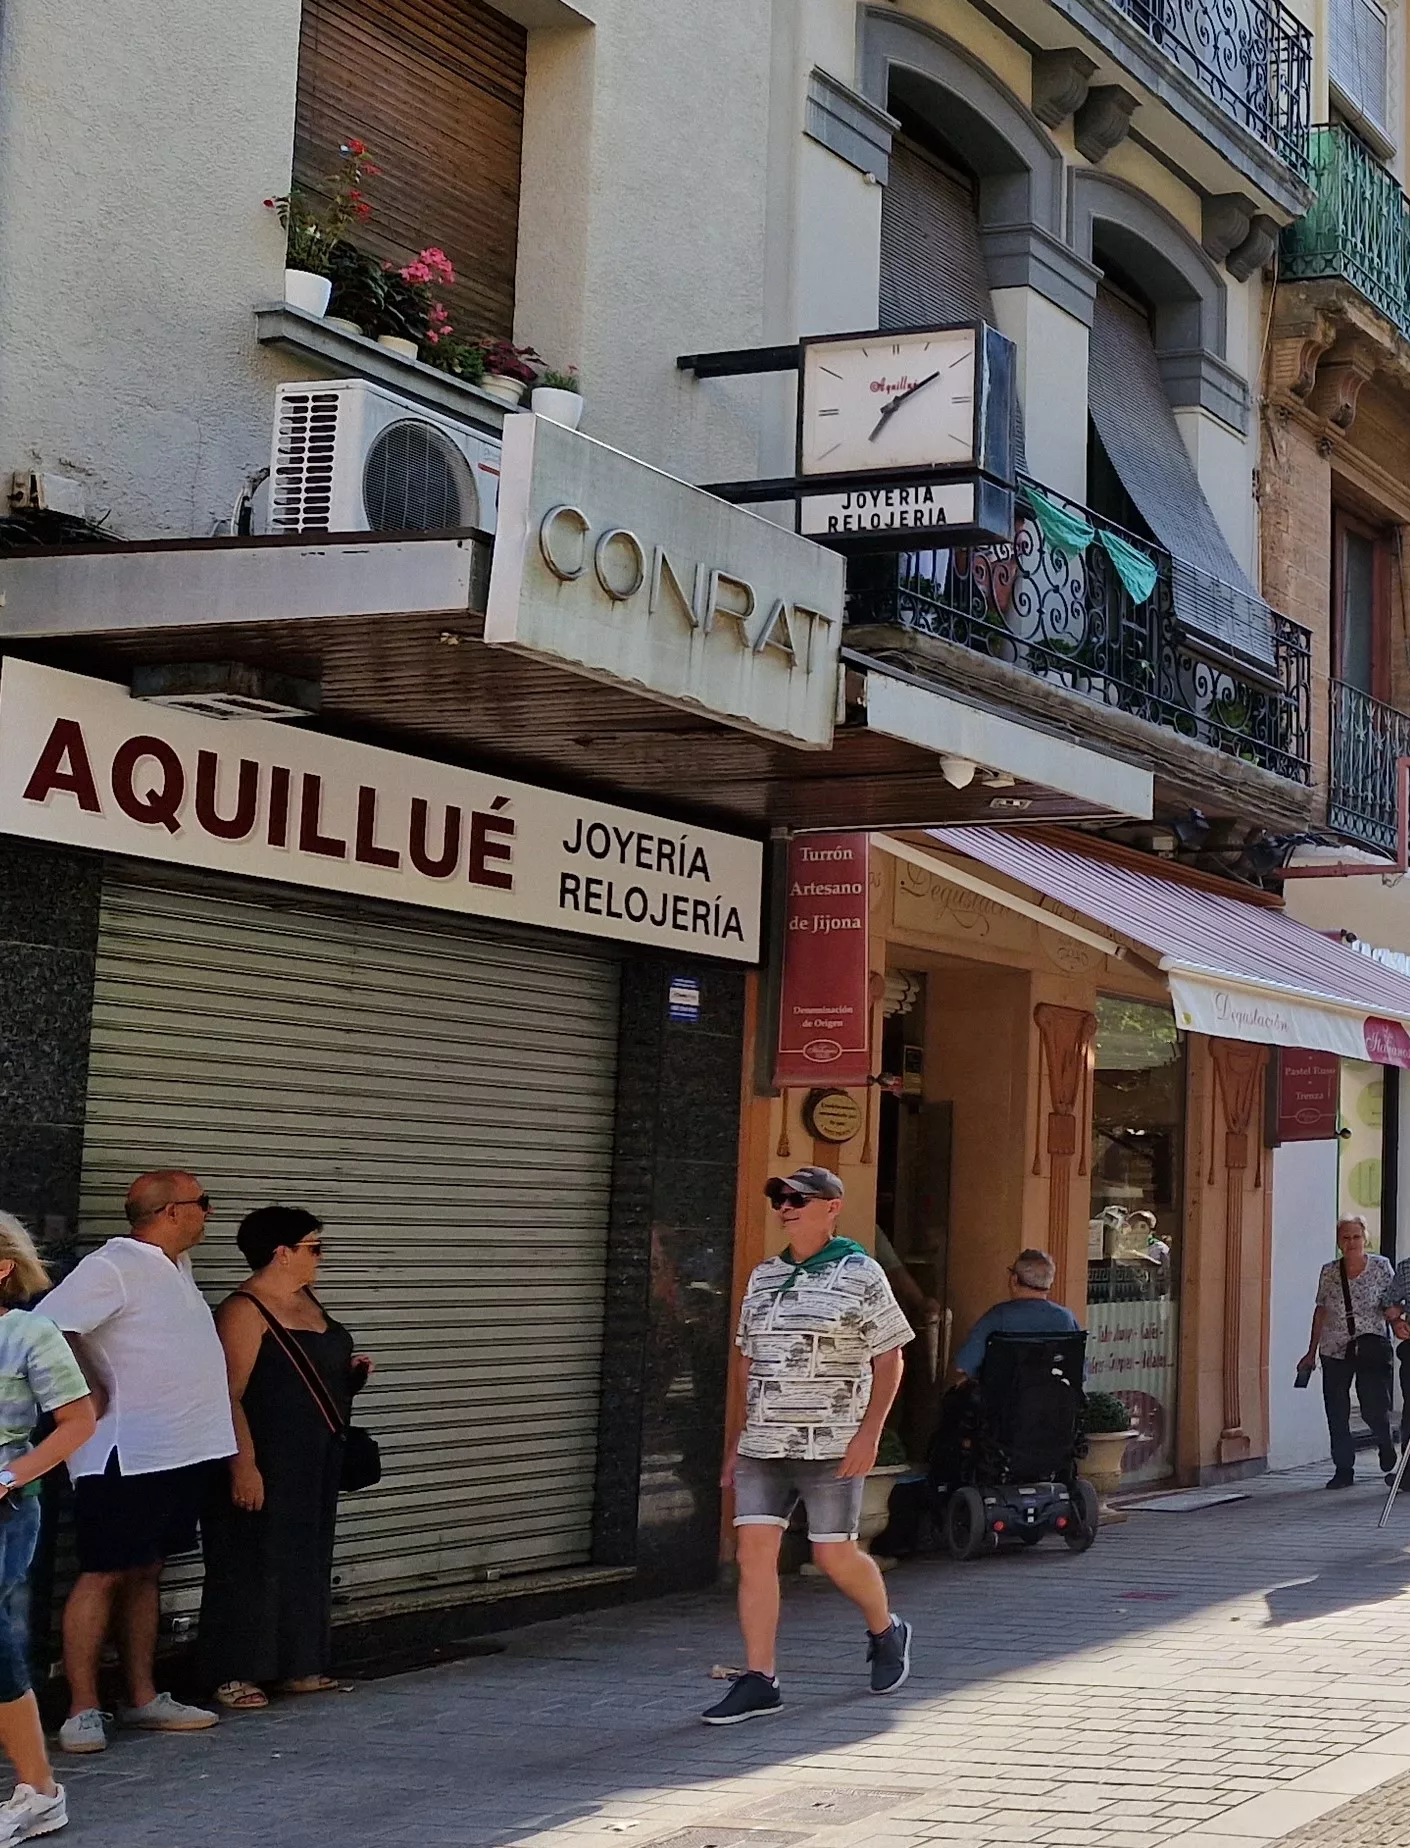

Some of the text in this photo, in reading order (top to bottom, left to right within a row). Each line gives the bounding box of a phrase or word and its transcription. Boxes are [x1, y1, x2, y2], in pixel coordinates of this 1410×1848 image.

[841, 485, 934, 510] JOYERIA
[828, 507, 947, 533] RELOJERIA
[540, 504, 834, 673] CONRAT
[22, 717, 515, 891] AQUILLUÉ
[562, 818, 711, 883] JOYERÍA
[800, 845, 854, 862] Turrón
[789, 881, 862, 897] Artesano
[558, 873, 745, 942] RELOJERÍA
[788, 914, 862, 935] de Jijona
[793, 1005, 853, 1015] Denominación
[1214, 991, 1289, 1034] Degustación
[802, 1019, 843, 1029] de Origen
